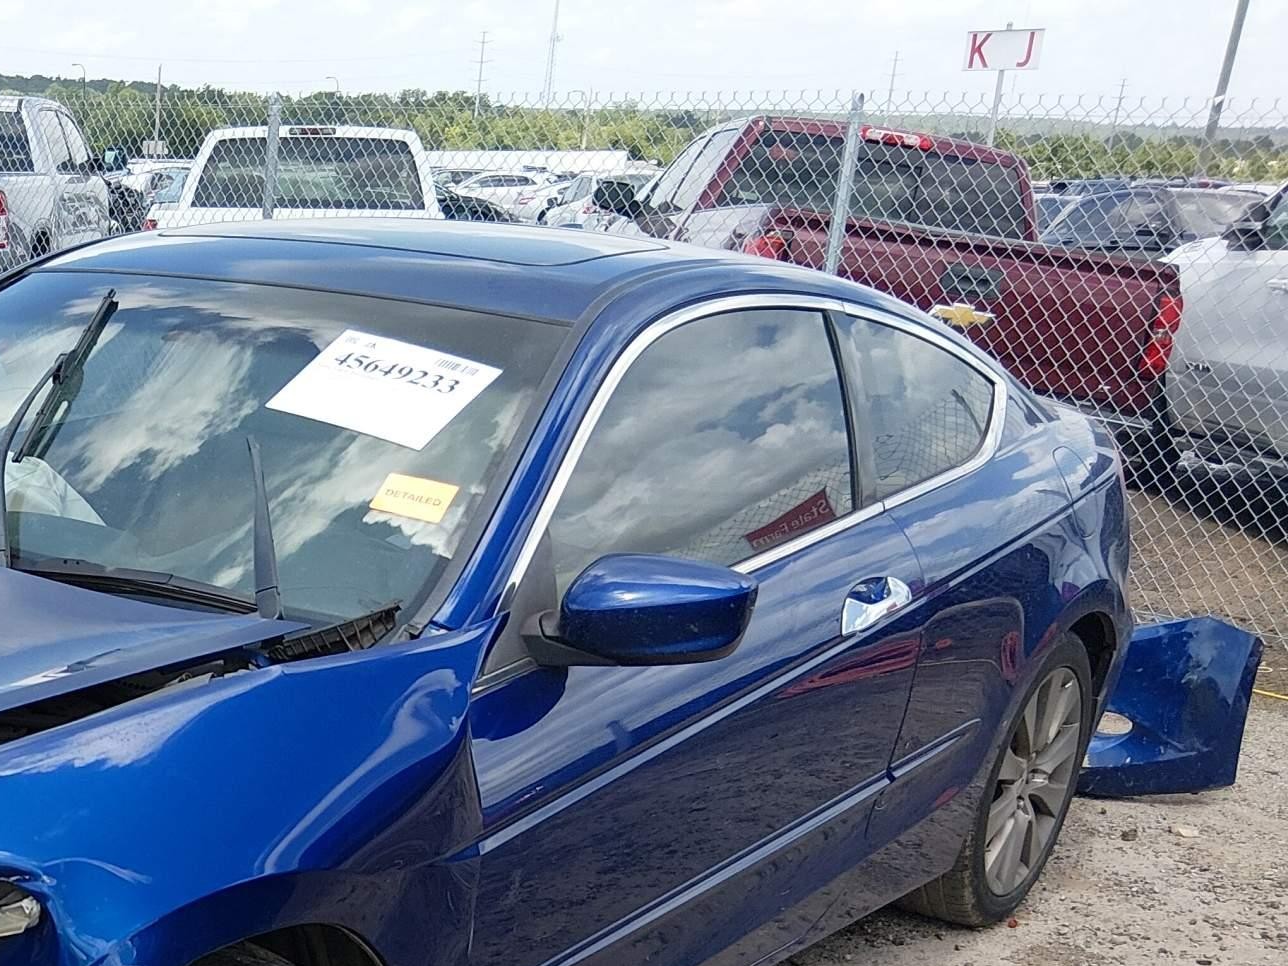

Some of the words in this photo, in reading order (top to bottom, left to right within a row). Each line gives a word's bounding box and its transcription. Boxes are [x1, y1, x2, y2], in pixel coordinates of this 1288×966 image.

[968, 32, 993, 68] K
[1015, 31, 1035, 67] J
[334, 352, 460, 394] 45649233
[384, 488, 443, 507] DETAILED
